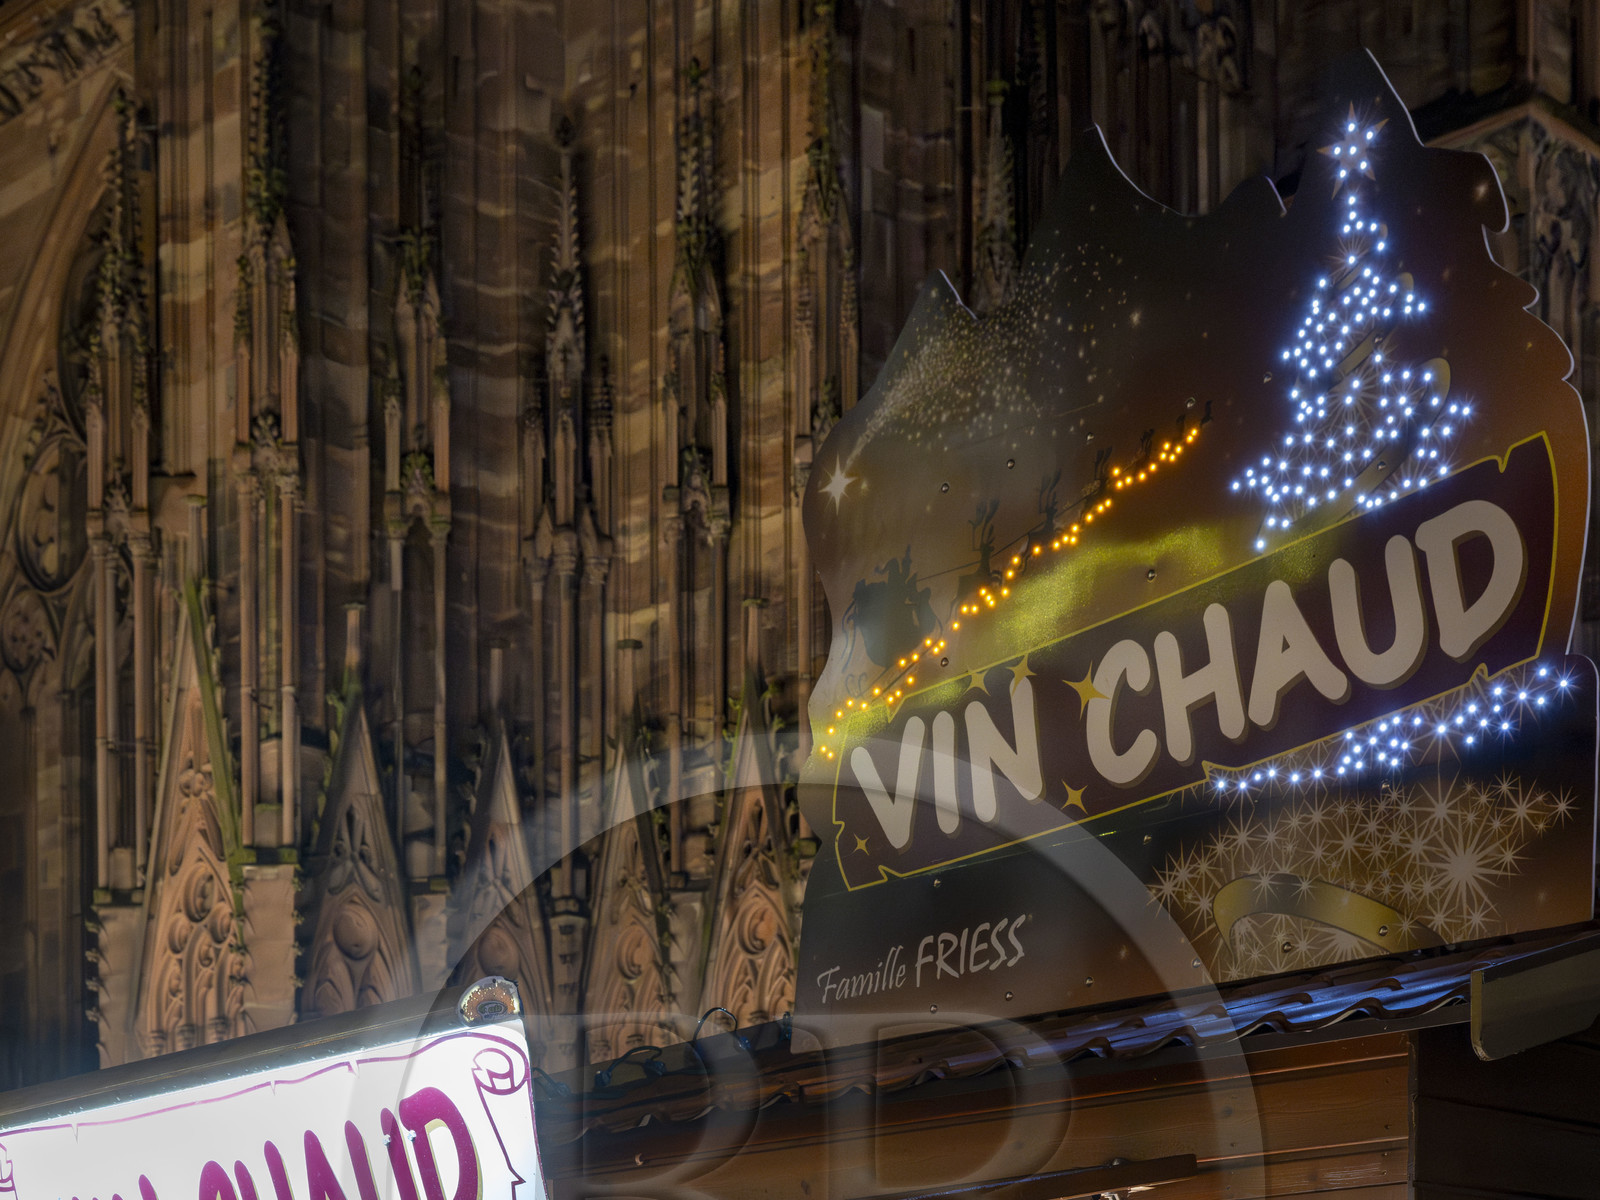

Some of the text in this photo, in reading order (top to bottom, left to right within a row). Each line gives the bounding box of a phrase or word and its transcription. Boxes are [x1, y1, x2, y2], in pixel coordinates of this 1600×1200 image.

[850, 500, 1525, 849] VIN CHAUD
[817, 913, 1027, 1003] Famille FRIESS
